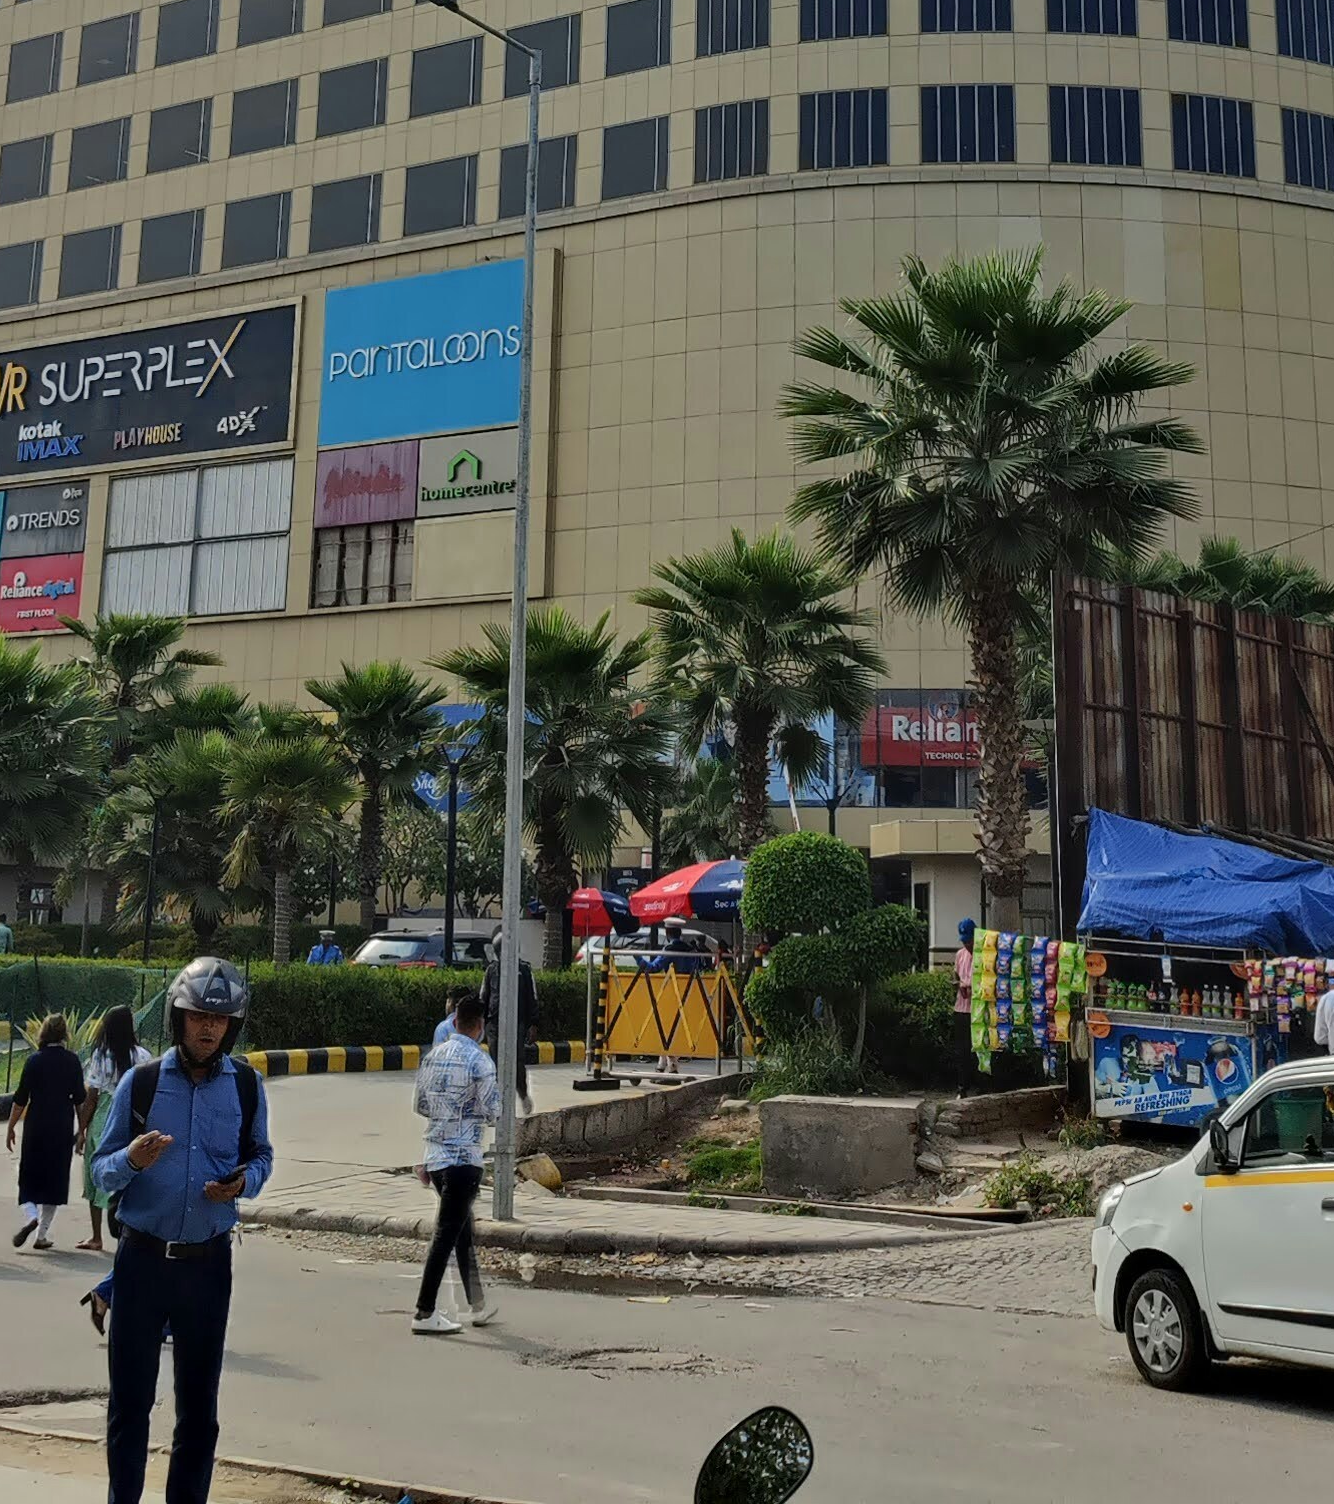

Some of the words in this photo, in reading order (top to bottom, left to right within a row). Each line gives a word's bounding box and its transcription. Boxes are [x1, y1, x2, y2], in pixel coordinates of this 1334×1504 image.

[38, 319, 247, 406] SUPERPLEX
[18, 419, 62, 441] kotak
[113, 422, 182, 450] PLAYHOUSE
[16, 435, 81, 462] IMAX
[19, 509, 80, 530] TRENDS
[892, 715, 981, 742] Relian
[1134, 1096, 1190, 1113] REFRESHING
